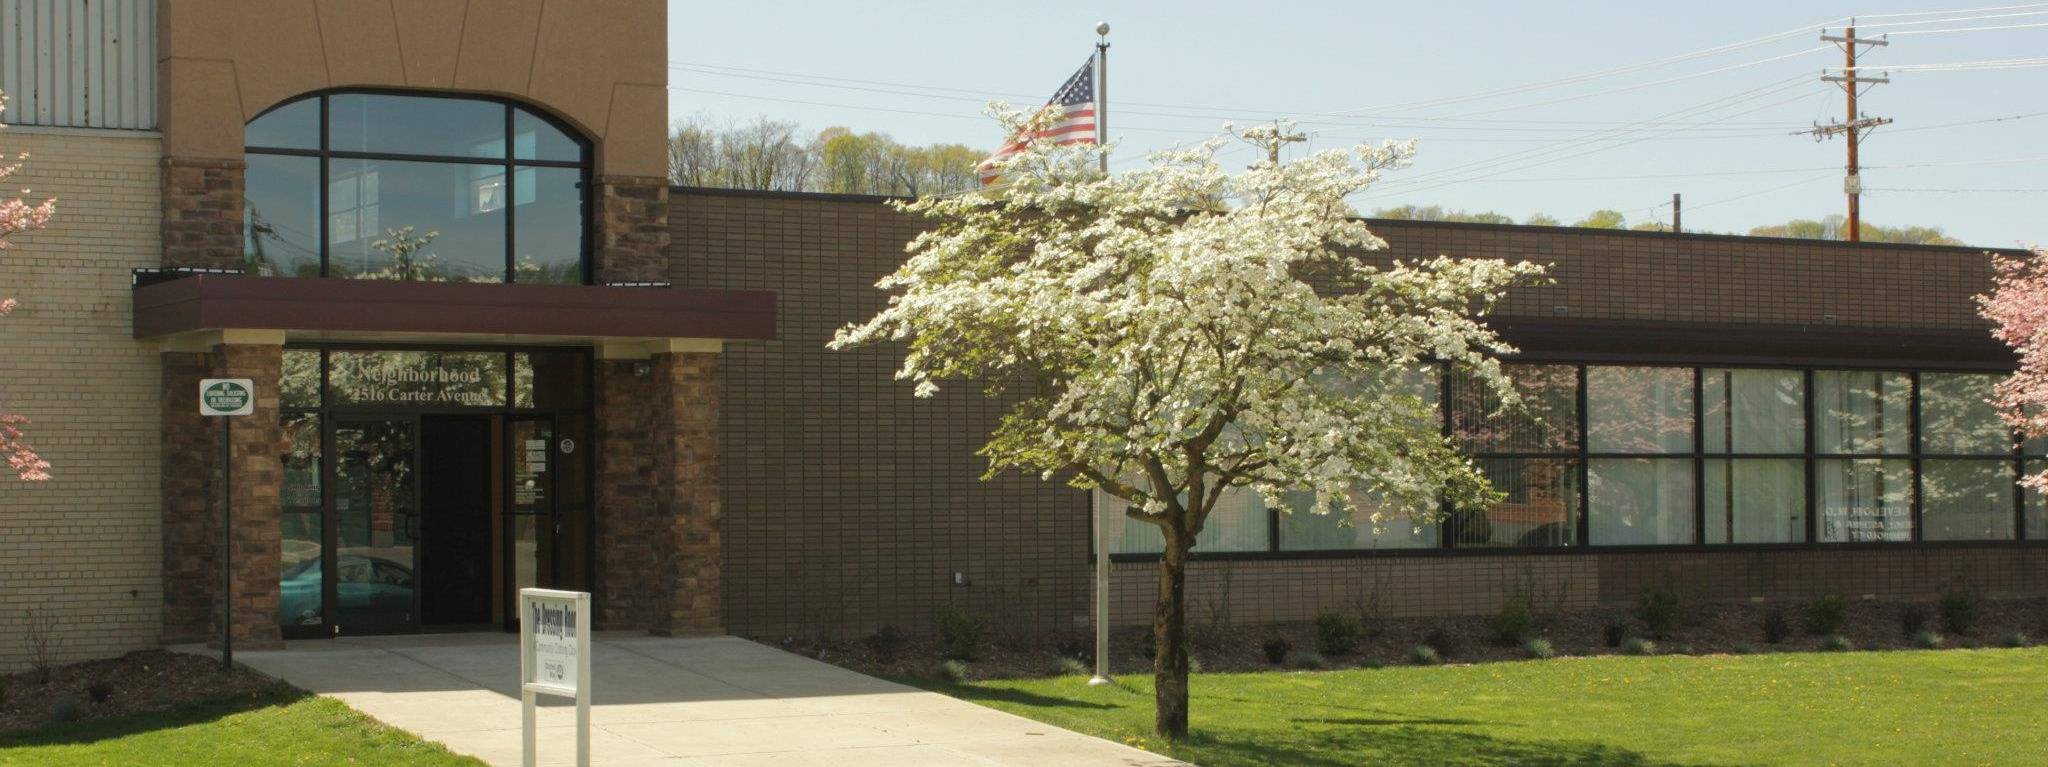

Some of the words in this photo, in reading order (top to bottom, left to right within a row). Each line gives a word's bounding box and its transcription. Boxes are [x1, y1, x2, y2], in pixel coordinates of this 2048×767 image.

[358, 365, 481, 385] Neighborhood
[350, 386, 386, 401] 2516
[388, 388, 434, 401] Carter
[437, 388, 489, 402] Avenue
